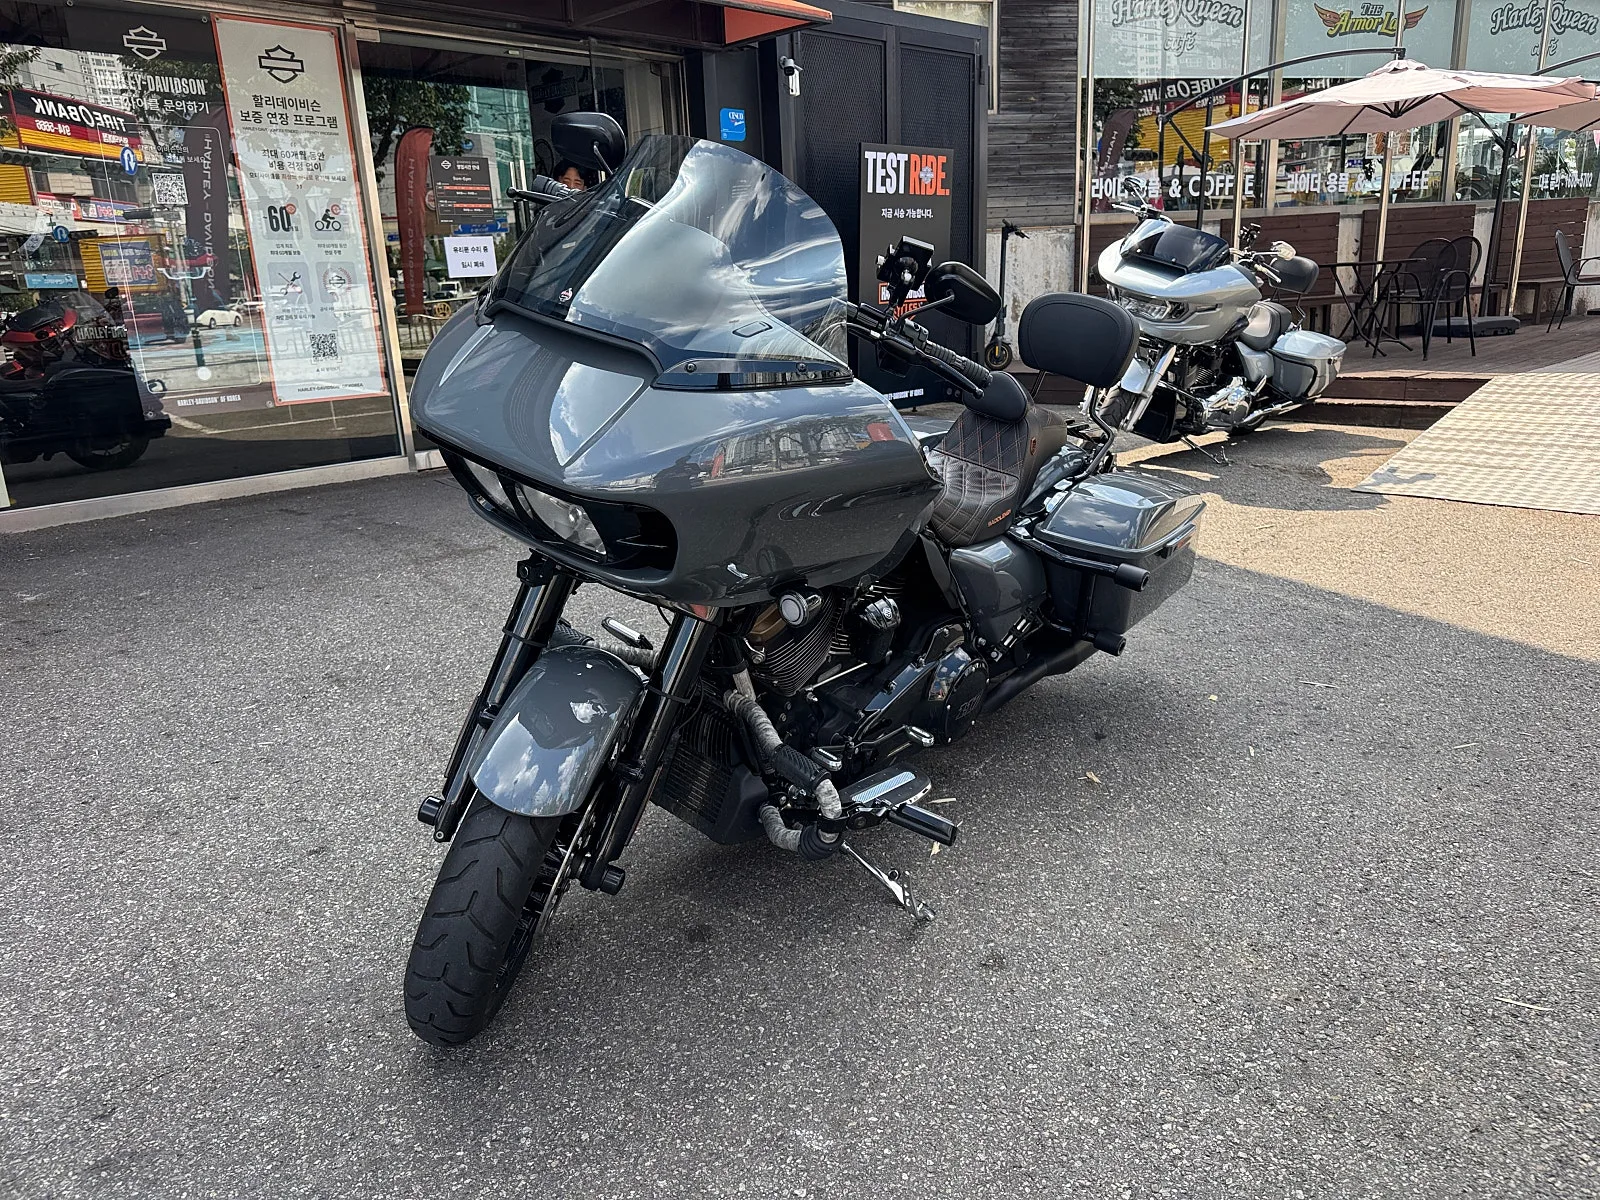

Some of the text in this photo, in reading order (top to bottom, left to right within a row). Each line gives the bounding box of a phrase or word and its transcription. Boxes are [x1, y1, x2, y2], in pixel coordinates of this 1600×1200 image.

[1361, 3, 1384, 15] THE
[163, 99, 209, 114] 문의하기
[252, 94, 321, 112] 할리데이비슨
[240, 110, 338, 129] 보증 연장 프로그램
[261, 149, 278, 159] 최대
[280, 150, 307, 160] 60개월
[269, 160, 284, 170] 비용
[306, 162, 322, 172] 없이
[865, 151, 950, 195] TEST RIDE.
[1168, 178, 1182, 198] &
[1188, 174, 1255, 197] COFFE
[1287, 172, 1321, 193] 라이더
[1327, 172, 1349, 193] 용품
[881, 208, 933, 219] 지금 시승 가능합니다.
